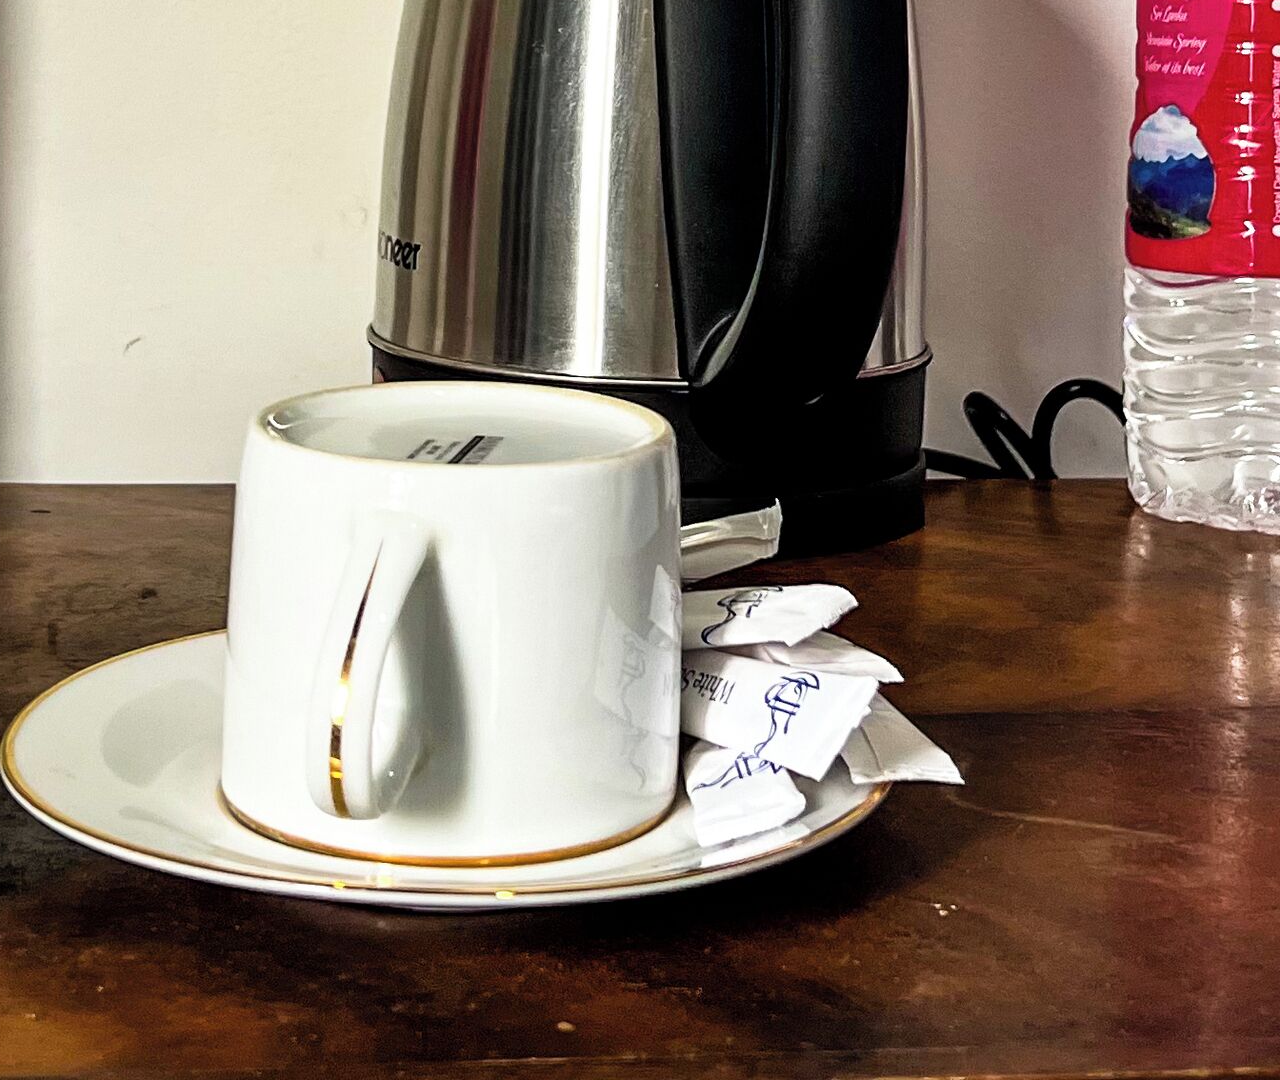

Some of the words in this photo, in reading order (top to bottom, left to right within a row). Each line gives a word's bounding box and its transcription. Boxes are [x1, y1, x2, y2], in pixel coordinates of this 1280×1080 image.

[1150, 5, 1163, 22] Sri
[1173, 33, 1207, 55] Spring
[1272, 60, 1280, 87] Water
